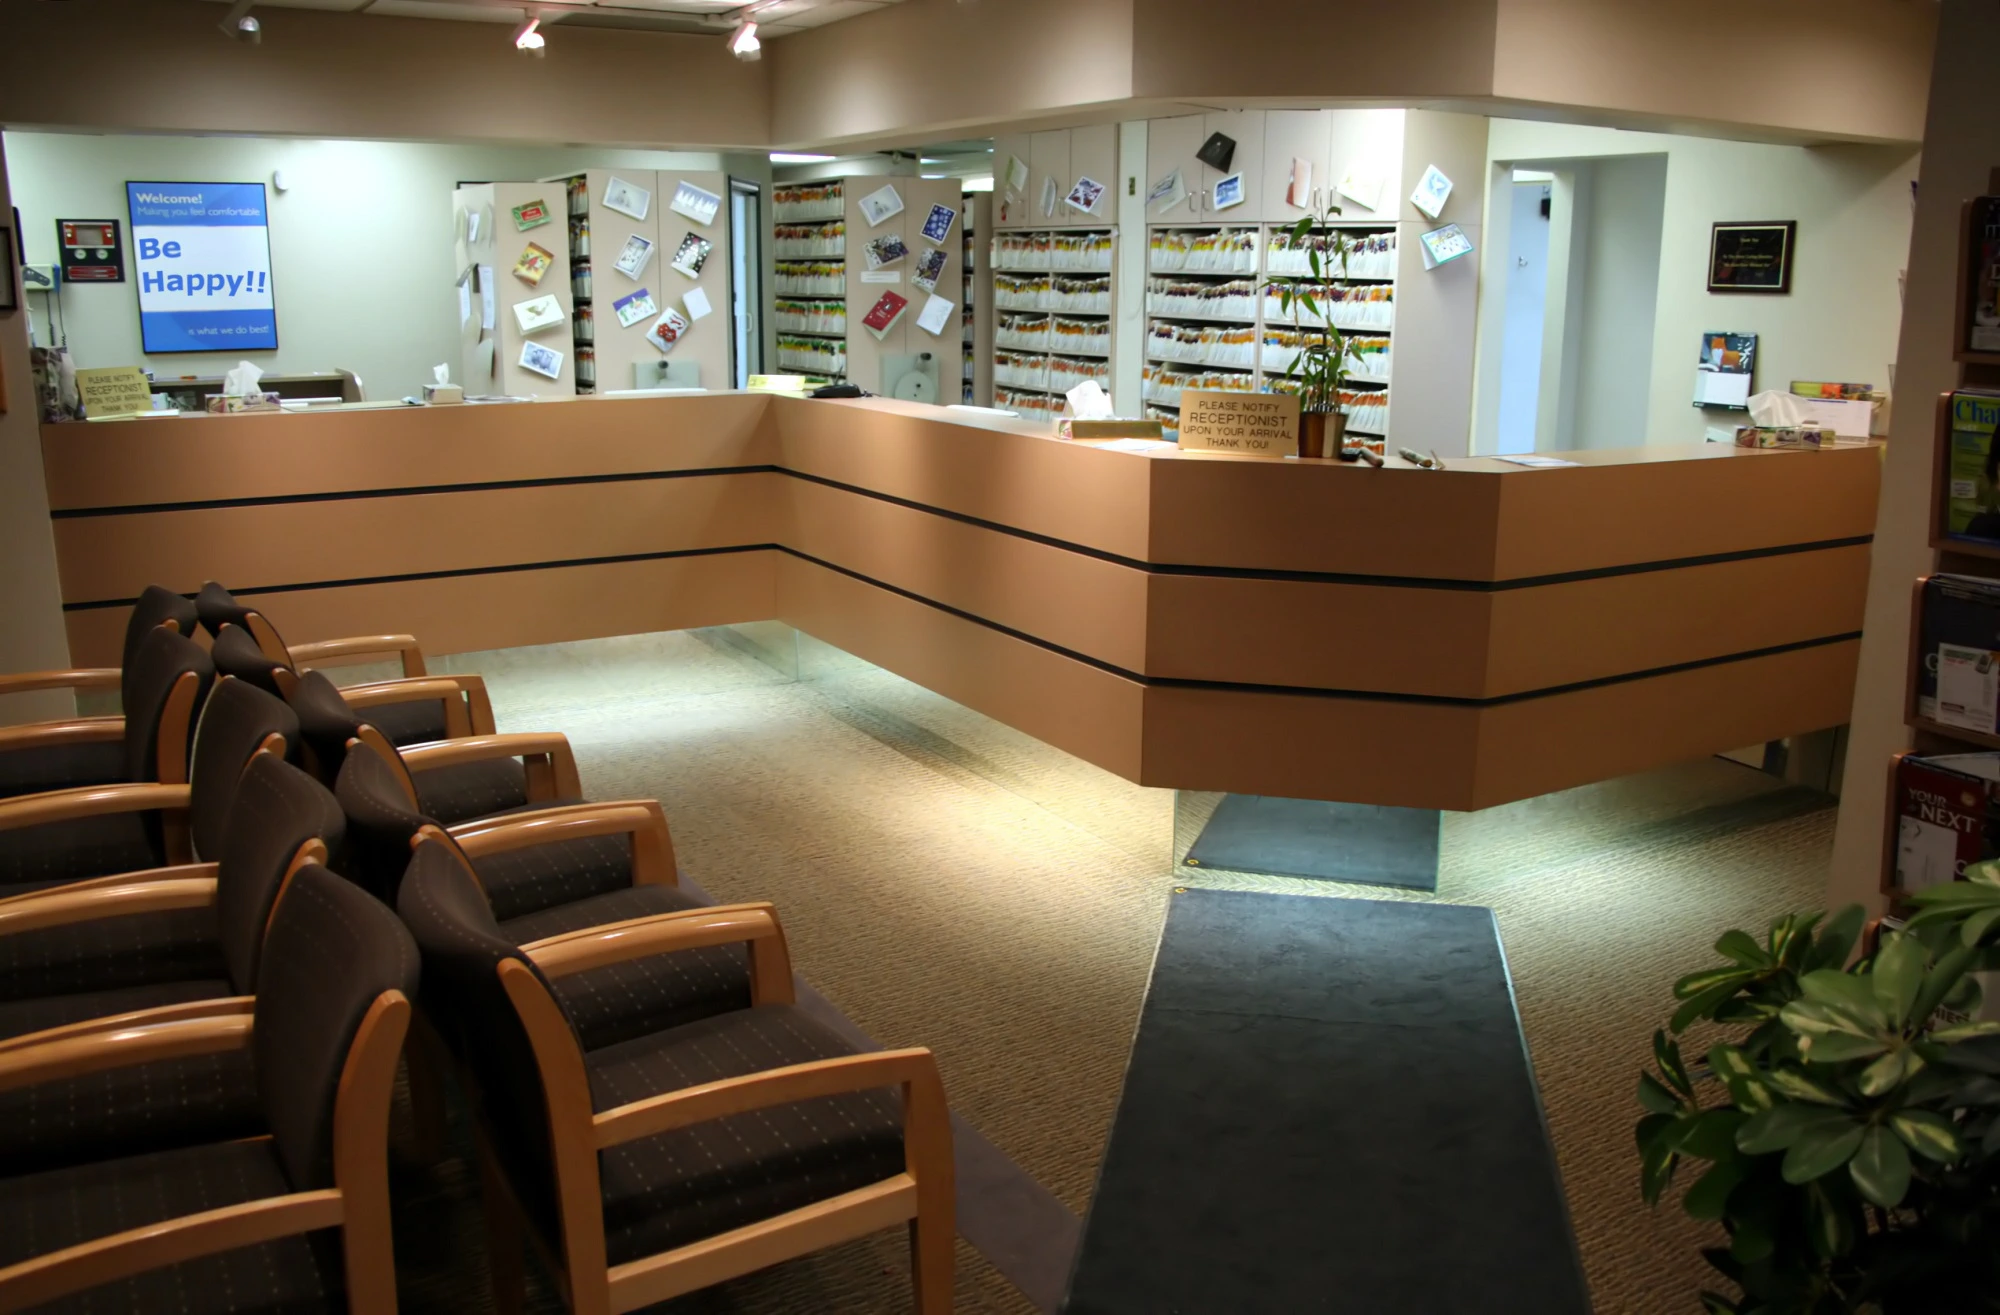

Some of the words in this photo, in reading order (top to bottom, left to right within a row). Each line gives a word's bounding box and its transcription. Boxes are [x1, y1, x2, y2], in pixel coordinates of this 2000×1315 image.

[136, 193, 203, 204] Welcome!
[137, 206, 170, 218] Making
[171, 208, 188, 218] you
[190, 206, 206, 216] feel
[208, 206, 261, 217] comfortable
[139, 237, 182, 261] Be
[142, 270, 266, 297] Happy!!
[197, 326, 218, 335] what
[235, 325, 248, 334] do
[86, 383, 142, 395] RECEPTIONIST
[1199, 400, 1239, 411] PLEASE
[1242, 403, 1280, 413] NOTIFY
[1190, 412, 1288, 427] RECEPTIONIST
[1183, 425, 1212, 435] UPON
[1216, 427, 1244, 437] YOUR
[1249, 428, 1293, 440] ARRIVAL
[1206, 437, 1240, 448] THANK
[1245, 439, 1269, 449] YOU!
[1908, 787, 1947, 808] YOUR
[1920, 802, 1977, 833] NEXT
